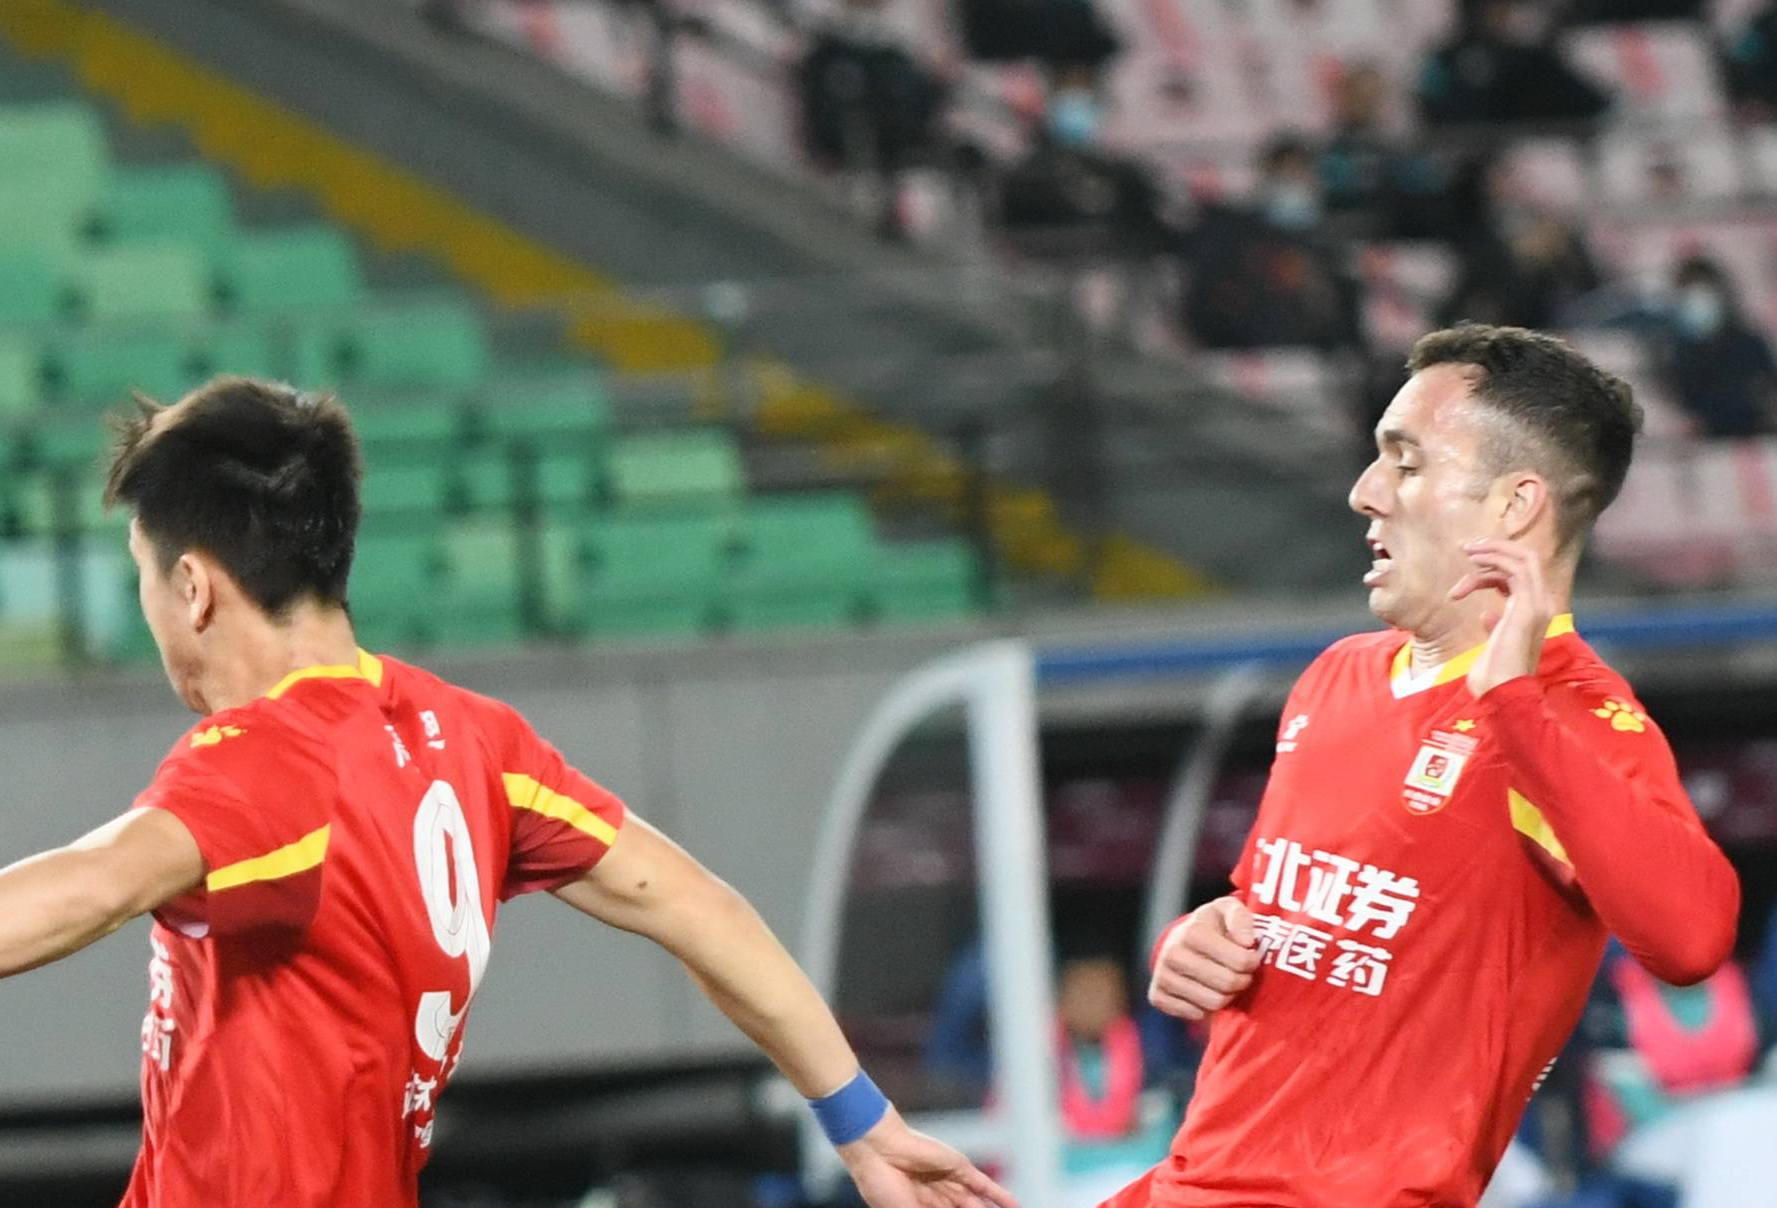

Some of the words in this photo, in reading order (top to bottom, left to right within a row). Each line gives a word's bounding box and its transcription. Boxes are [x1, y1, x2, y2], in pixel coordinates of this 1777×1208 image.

[413, 779, 491, 1062] 9
[1250, 837, 1420, 940] 北证券
